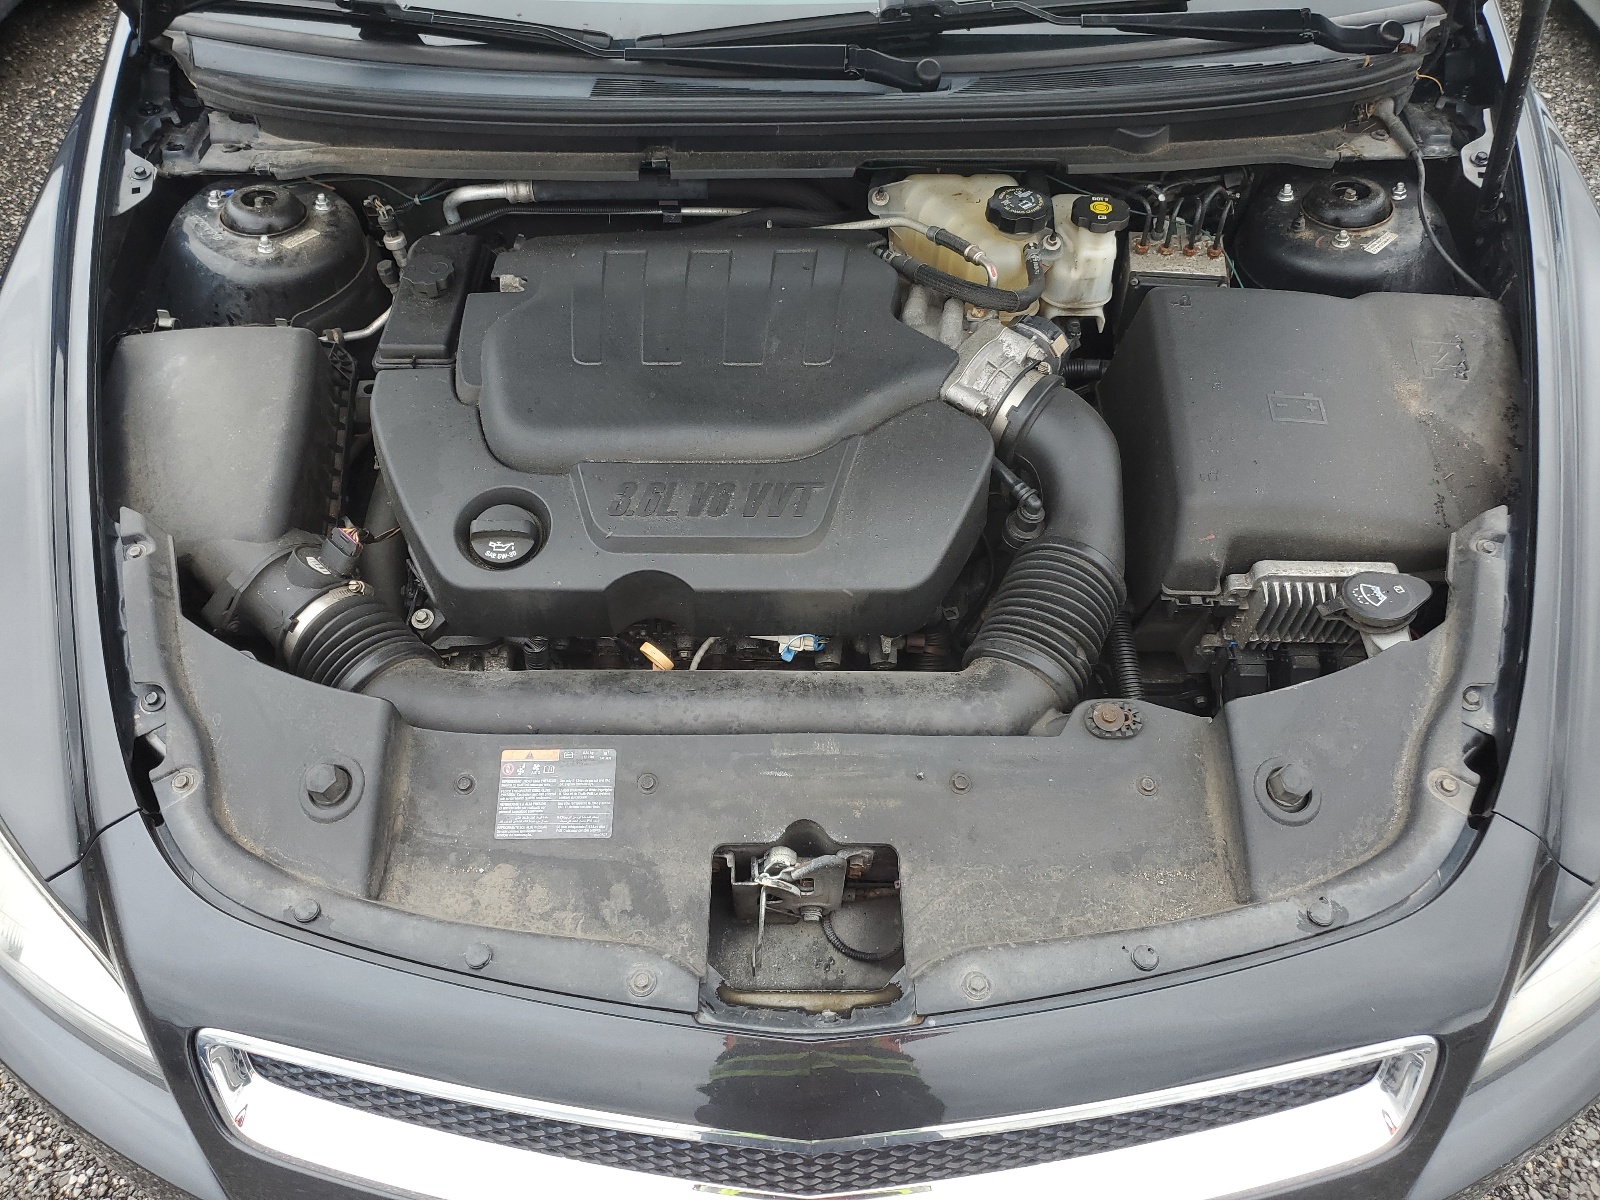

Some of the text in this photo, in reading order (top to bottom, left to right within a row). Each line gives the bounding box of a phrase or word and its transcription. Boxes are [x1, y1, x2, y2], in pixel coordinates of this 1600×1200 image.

[606, 480, 826, 519] 3.6L V6 VVT
[484, 550, 497, 559] SAE
